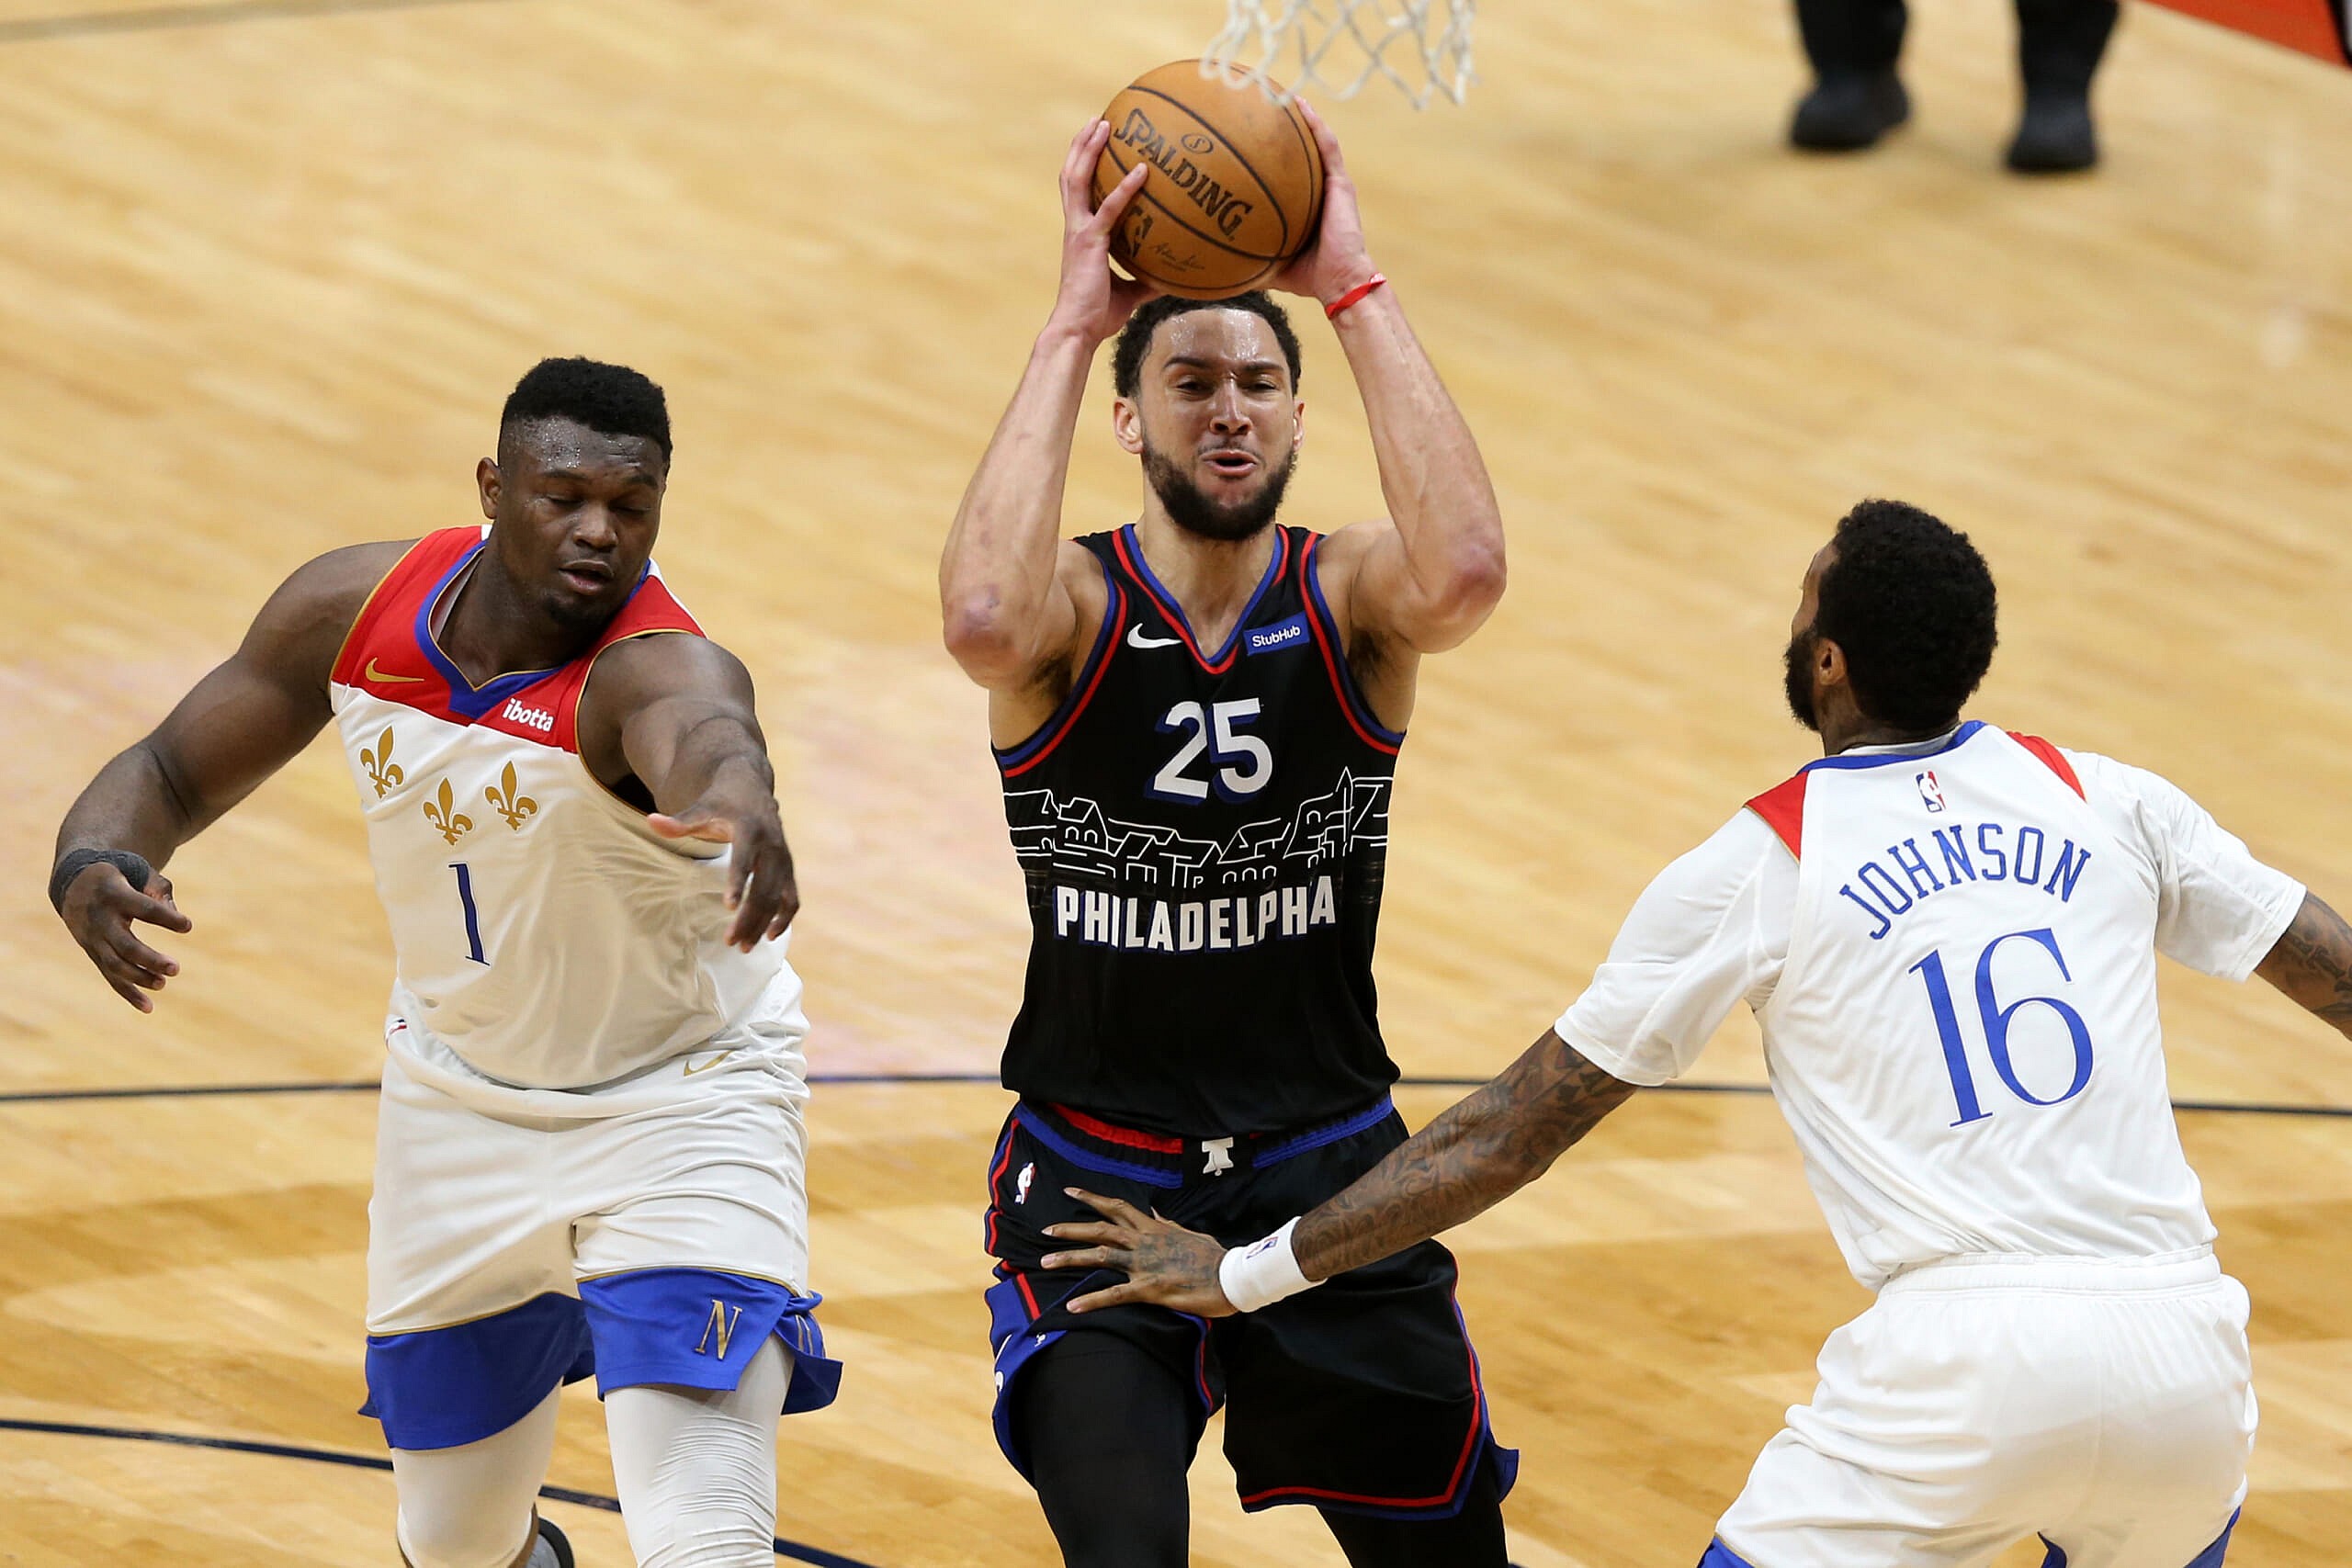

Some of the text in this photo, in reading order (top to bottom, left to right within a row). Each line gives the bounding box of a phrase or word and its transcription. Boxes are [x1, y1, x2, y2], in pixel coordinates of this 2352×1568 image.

[1114, 107, 1252, 237] SPALDING
[1252, 626, 1301, 647] StubHub
[503, 697, 554, 732] ibotta
[1146, 698, 1272, 804] 25
[448, 863, 491, 966] 1
[1055, 874, 1336, 952] PHILADELPHA
[1839, 823, 2091, 940] JOHNSON
[1908, 928, 2094, 1128] 16
[695, 1299, 742, 1360] N
